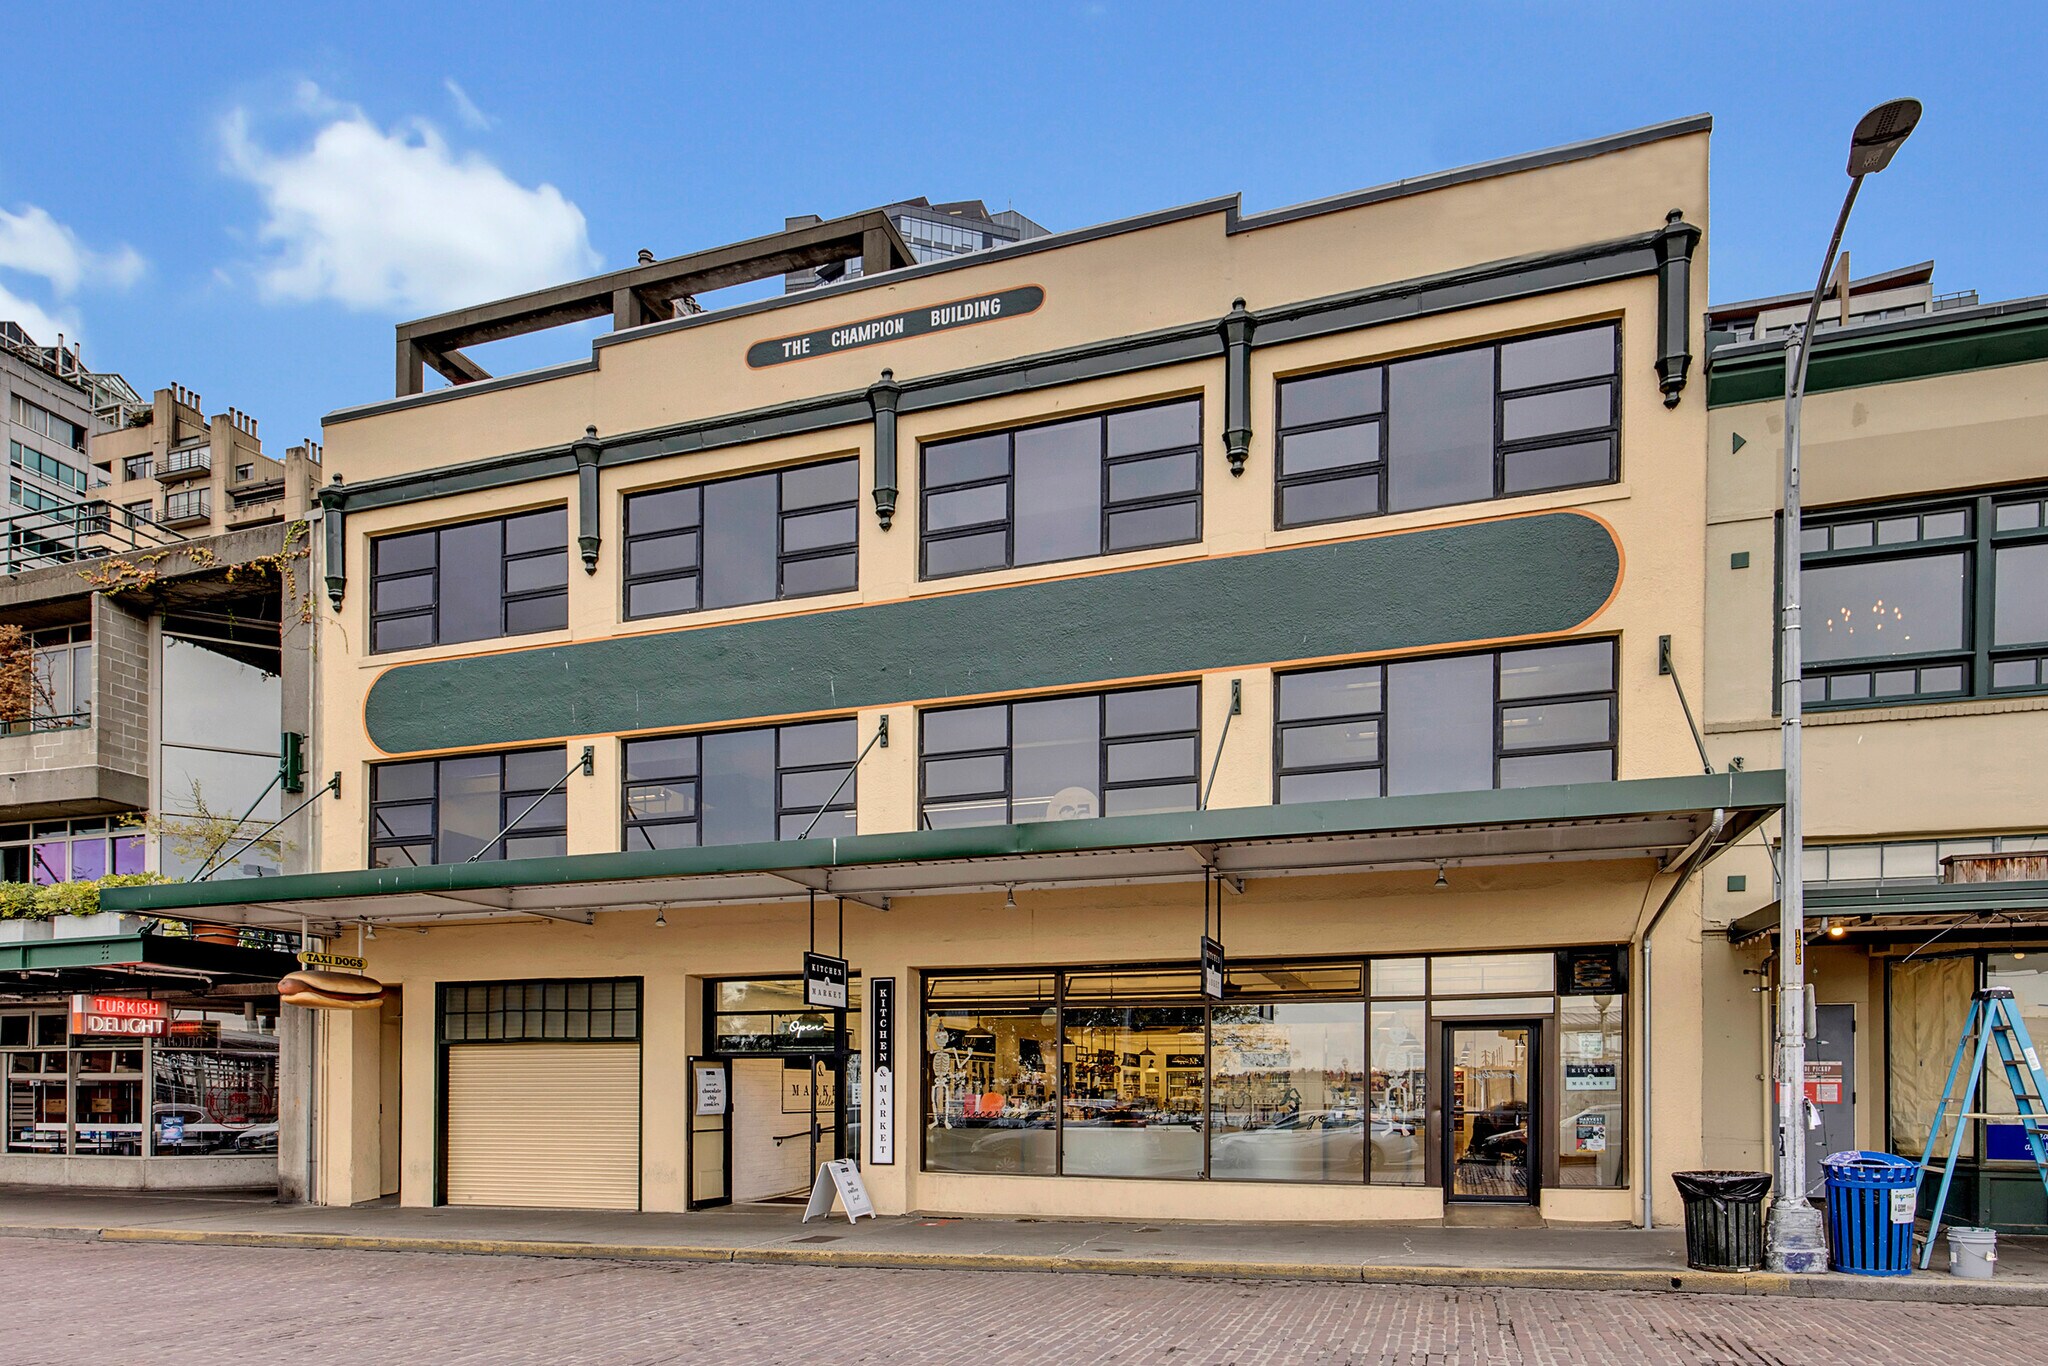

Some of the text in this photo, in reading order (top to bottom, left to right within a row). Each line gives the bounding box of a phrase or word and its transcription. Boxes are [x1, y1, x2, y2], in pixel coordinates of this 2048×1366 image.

[782, 297, 1001, 358] THE CHAMPION BUILDING
[307, 953, 363, 968] TAXI DOGS
[811, 963, 842, 977] KITCHEN
[811, 987, 842, 999] MARKET
[96, 998, 159, 1015] TURKISH
[90, 1016, 164, 1034] DELIGHT
[789, 1020, 824, 1038] Open
[879, 988, 888, 1062] KITCHEN
[818, 1064, 824, 1077] &
[879, 1069, 887, 1078] &
[792, 1084, 836, 1097] MARK
[879, 1084, 887, 1154] MARKET
